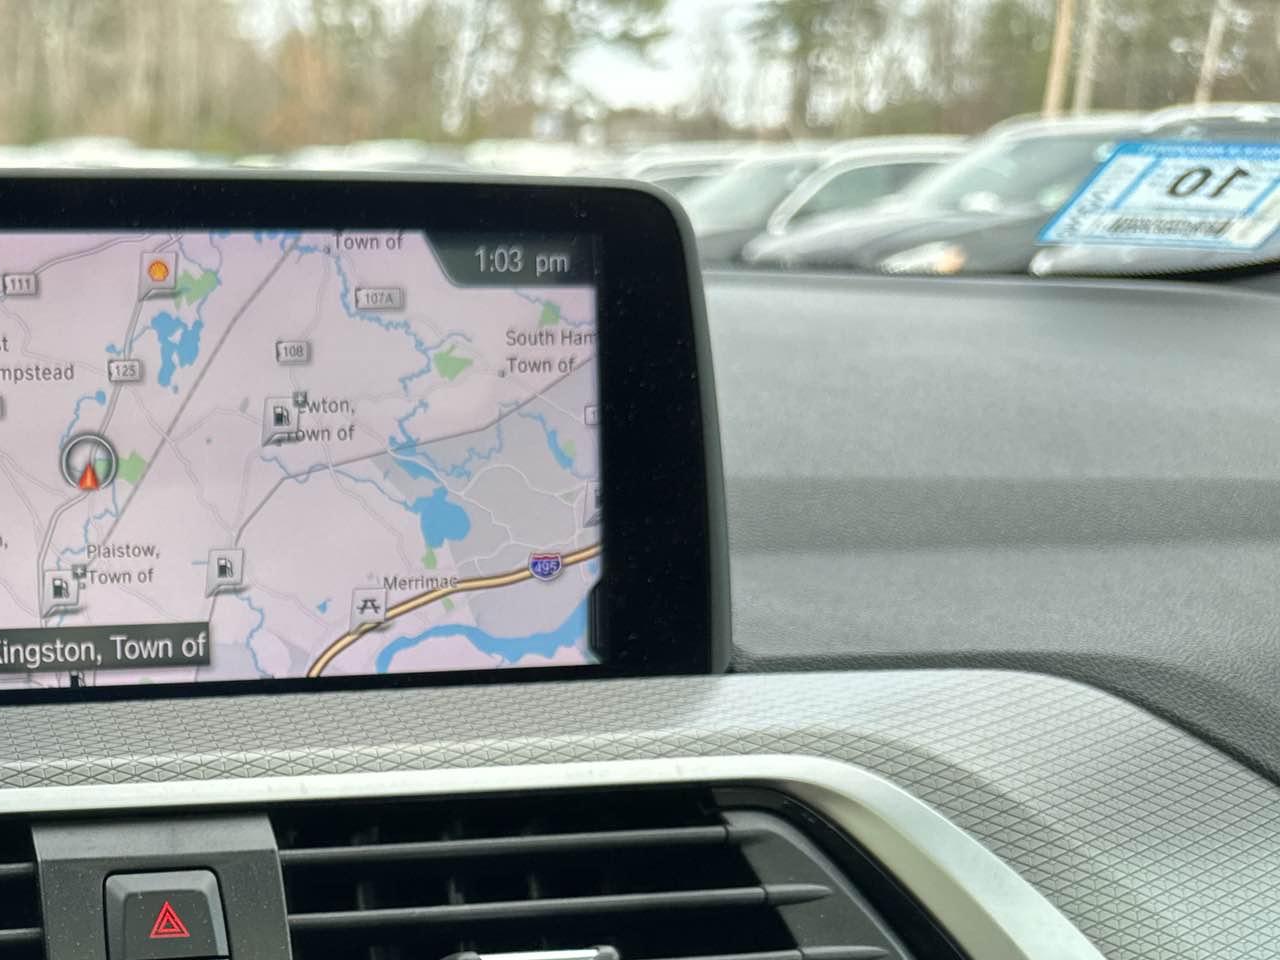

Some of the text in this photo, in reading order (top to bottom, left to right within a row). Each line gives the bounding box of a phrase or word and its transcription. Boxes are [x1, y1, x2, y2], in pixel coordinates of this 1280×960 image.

[334, 232, 404, 250] Town of
[475, 246, 569, 277] 1:03 pm
[10, 278, 31, 290] 111
[365, 293, 394, 304] 107A
[506, 329, 554, 346] South
[284, 346, 304, 358] 108
[115, 365, 136, 377] 125
[507, 356, 575, 373] Town of
[337, 425, 355, 441] of
[87, 544, 160, 560] Plaistow,
[534, 560, 558, 573] 495
[88, 568, 154, 585] Town of
[110, 634, 172, 661] Town
[182, 631, 207, 658] of
